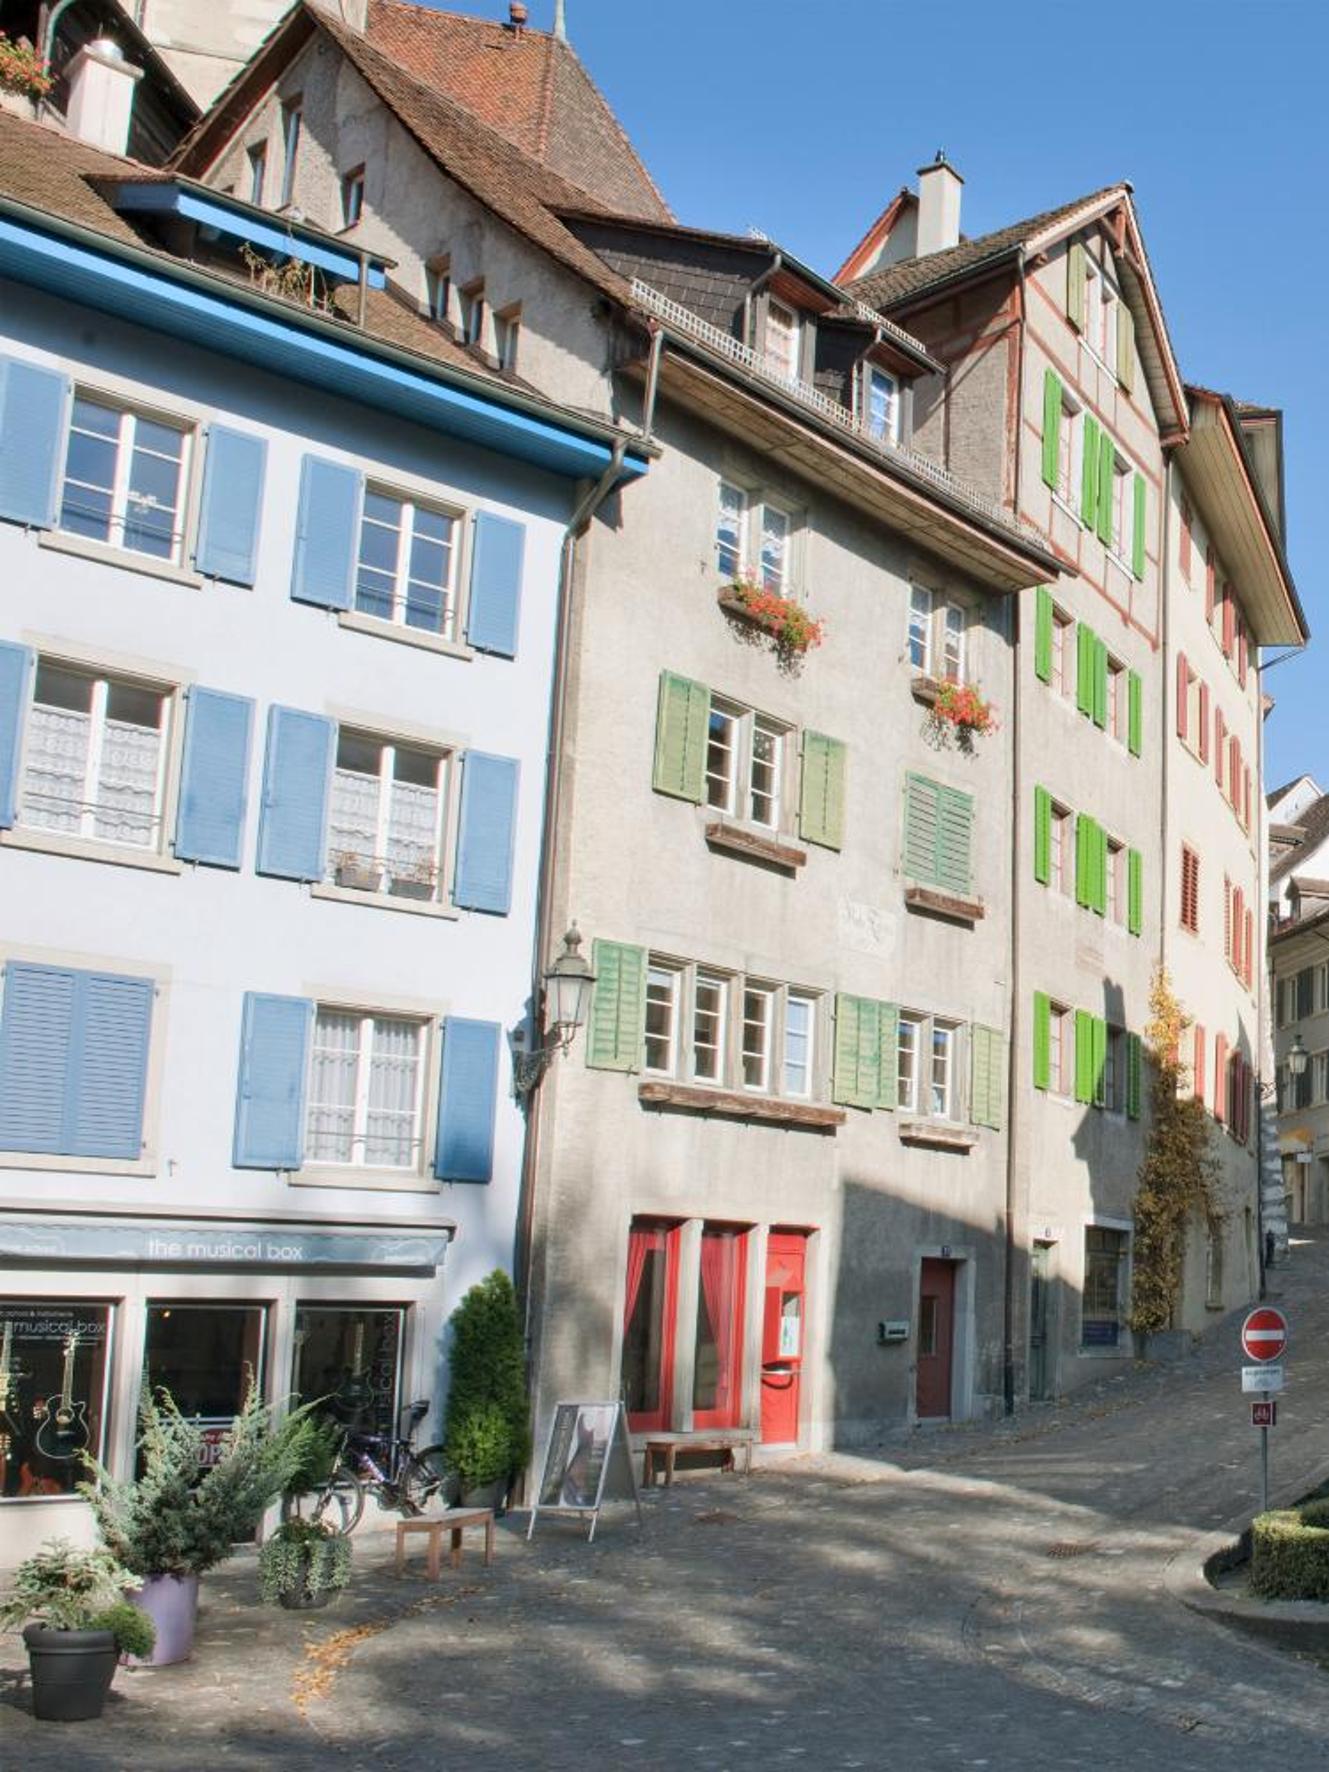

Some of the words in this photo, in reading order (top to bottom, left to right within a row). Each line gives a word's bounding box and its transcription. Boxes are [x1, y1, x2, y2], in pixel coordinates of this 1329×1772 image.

[149, 1240, 179, 1257] the
[187, 1241, 262, 1259] musical
[267, 1242, 303, 1261] box
[14, 1320, 74, 1334] musical
[77, 1319, 106, 1334] box
